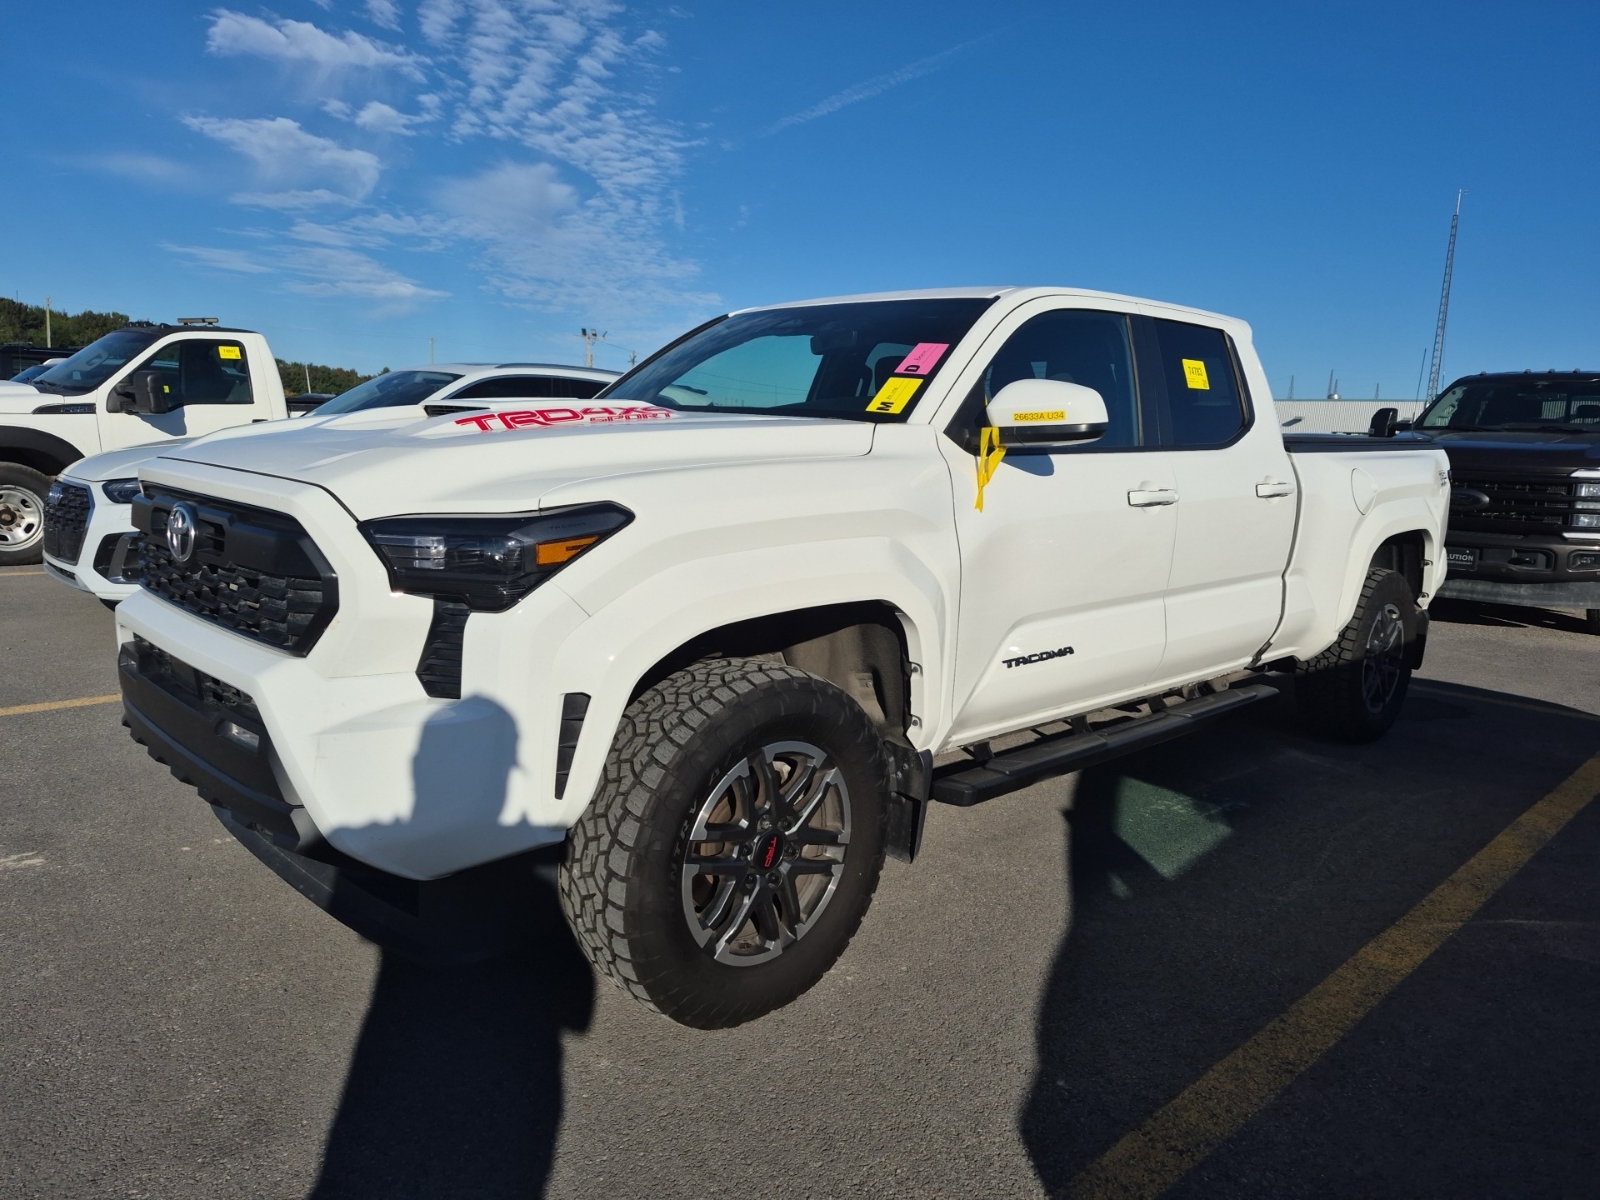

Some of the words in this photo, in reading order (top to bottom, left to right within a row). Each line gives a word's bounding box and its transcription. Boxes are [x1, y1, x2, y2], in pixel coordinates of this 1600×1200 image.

[903, 364, 921, 373] D
[875, 401, 895, 412] M
[454, 408, 584, 432] TRD
[590, 413, 670, 422] SPORT
[1014, 412, 1045, 421] 26633A
[1047, 411, 1064, 420] U34
[1447, 553, 1474, 562] UTION
[1002, 646, 1075, 669] TACOMA
[764, 836, 777, 867] TRD
